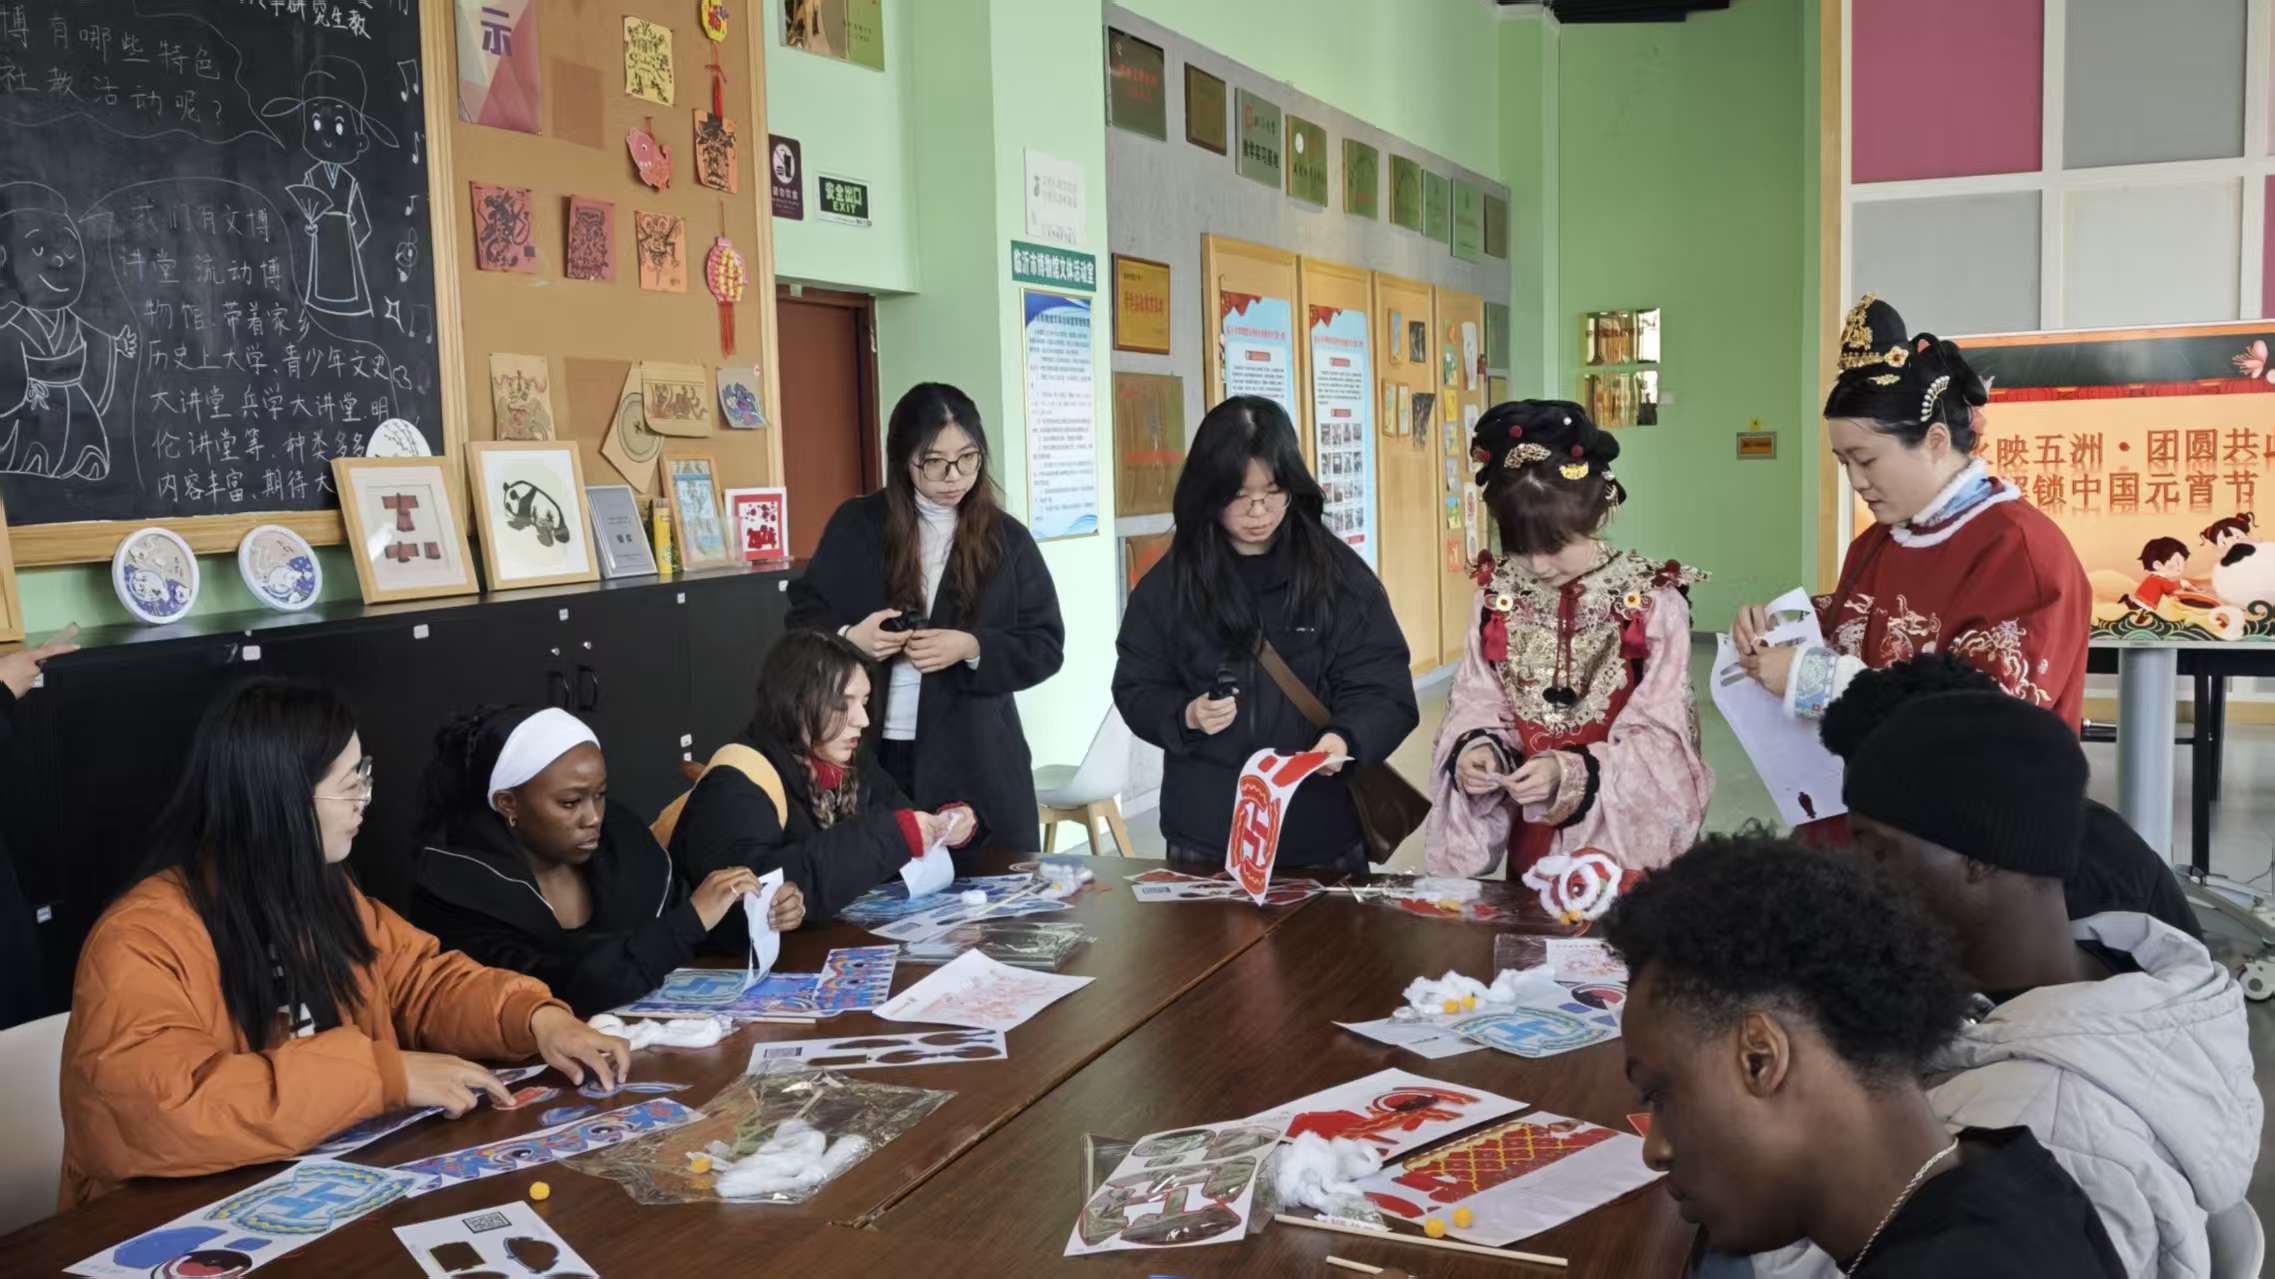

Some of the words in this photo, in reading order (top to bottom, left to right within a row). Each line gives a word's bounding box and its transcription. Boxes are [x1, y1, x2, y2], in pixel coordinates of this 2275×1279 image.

[825, 181, 862, 206] 安全出口
[832, 201, 857, 215] EXIT
